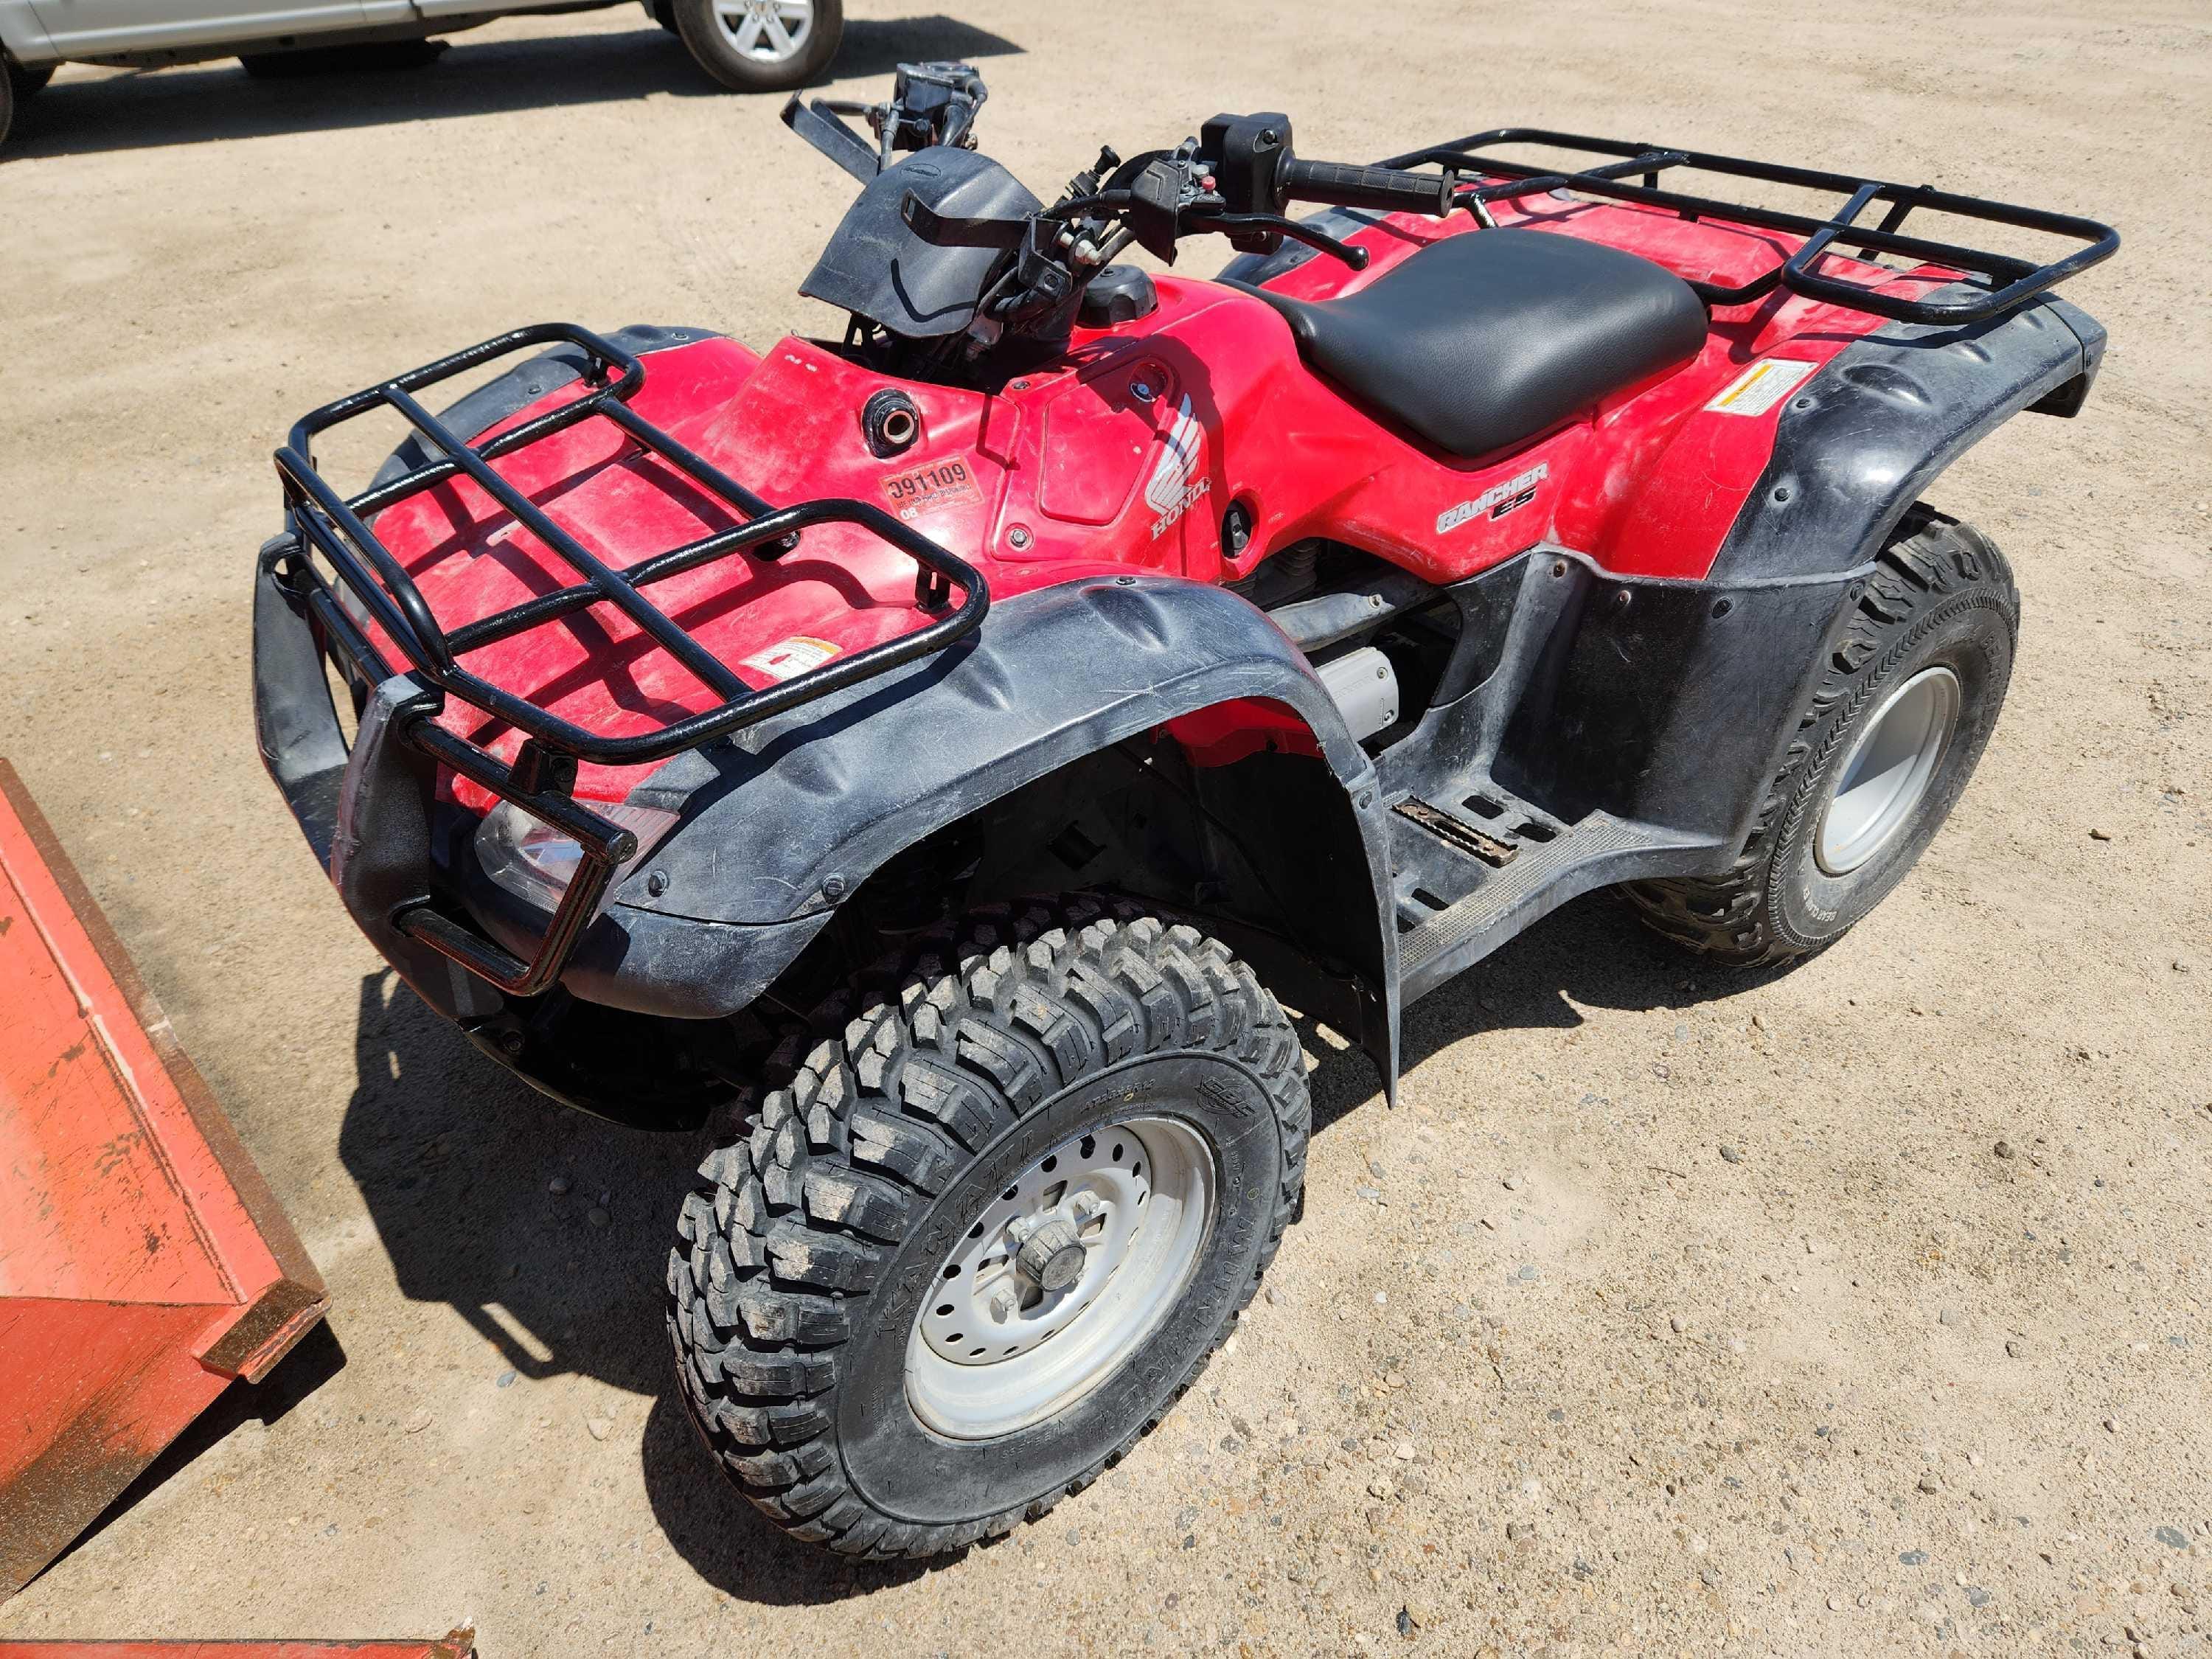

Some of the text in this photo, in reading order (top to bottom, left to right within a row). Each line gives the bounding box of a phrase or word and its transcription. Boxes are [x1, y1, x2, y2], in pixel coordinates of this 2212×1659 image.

[900, 507, 918, 520] 08
[1150, 477, 1212, 541] HONDA
[1437, 461, 1549, 533] RANCHER
[1490, 485, 1537, 521] ES
